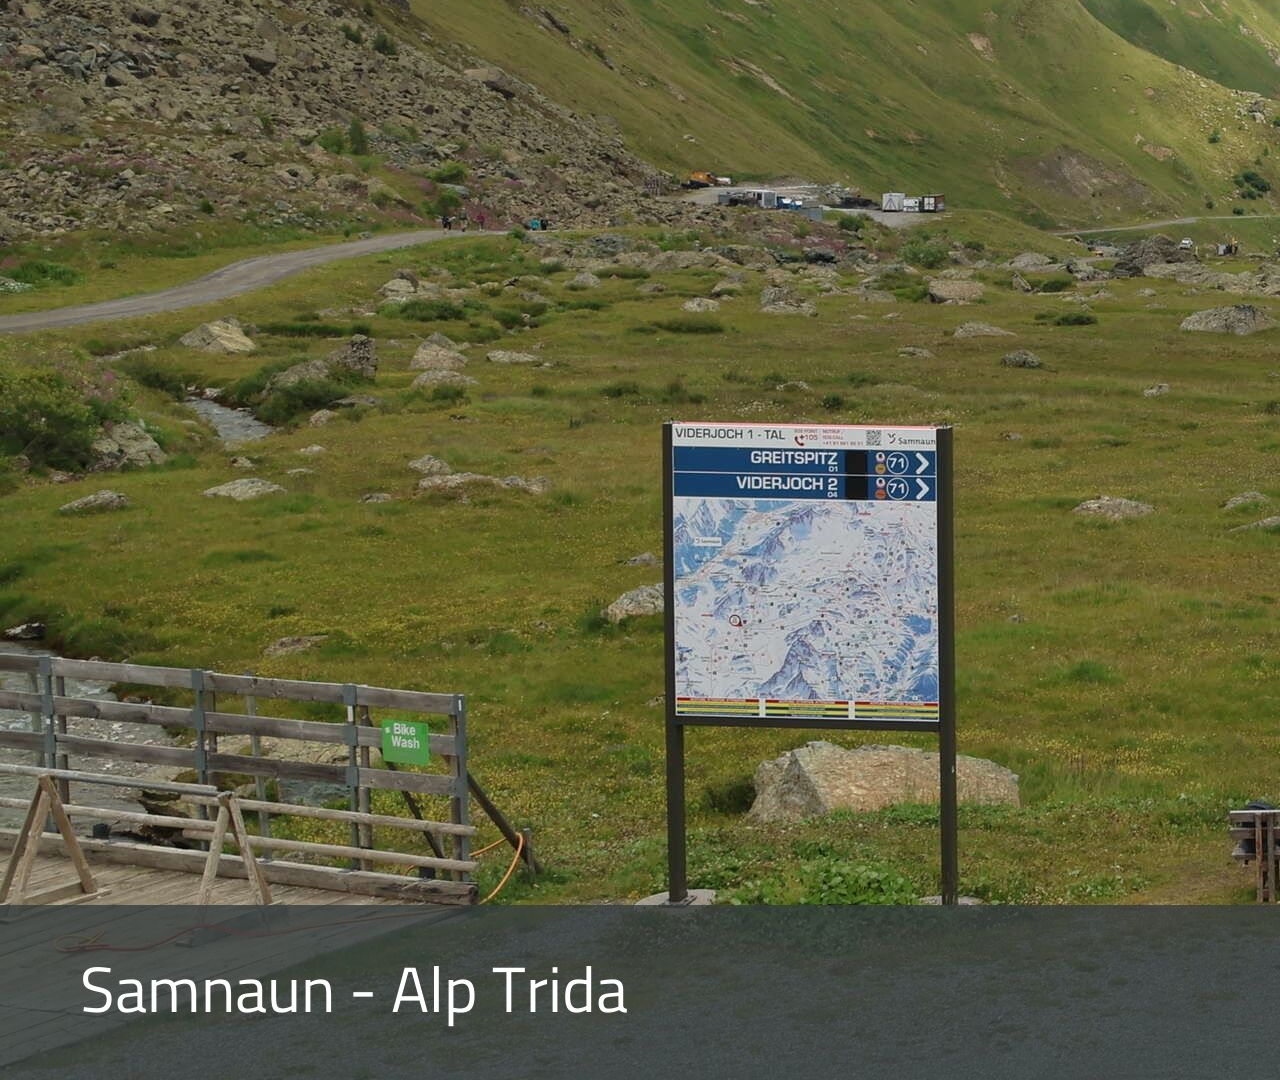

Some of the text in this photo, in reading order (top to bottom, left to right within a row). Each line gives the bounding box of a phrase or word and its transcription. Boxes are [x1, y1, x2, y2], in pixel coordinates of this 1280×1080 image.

[675, 427, 743, 439] VIDERJOCH
[747, 429, 754, 439] 1
[764, 429, 786, 440] TAL
[897, 436, 936, 445] Samnaun
[750, 450, 839, 465] GREITSPITZ
[889, 457, 905, 469] 71
[828, 465, 839, 473] 01
[736, 475, 839, 491] VIDERJOCH 2
[889, 483, 905, 495] 71
[393, 722, 416, 735] Bike
[391, 735, 420, 749] Wash
